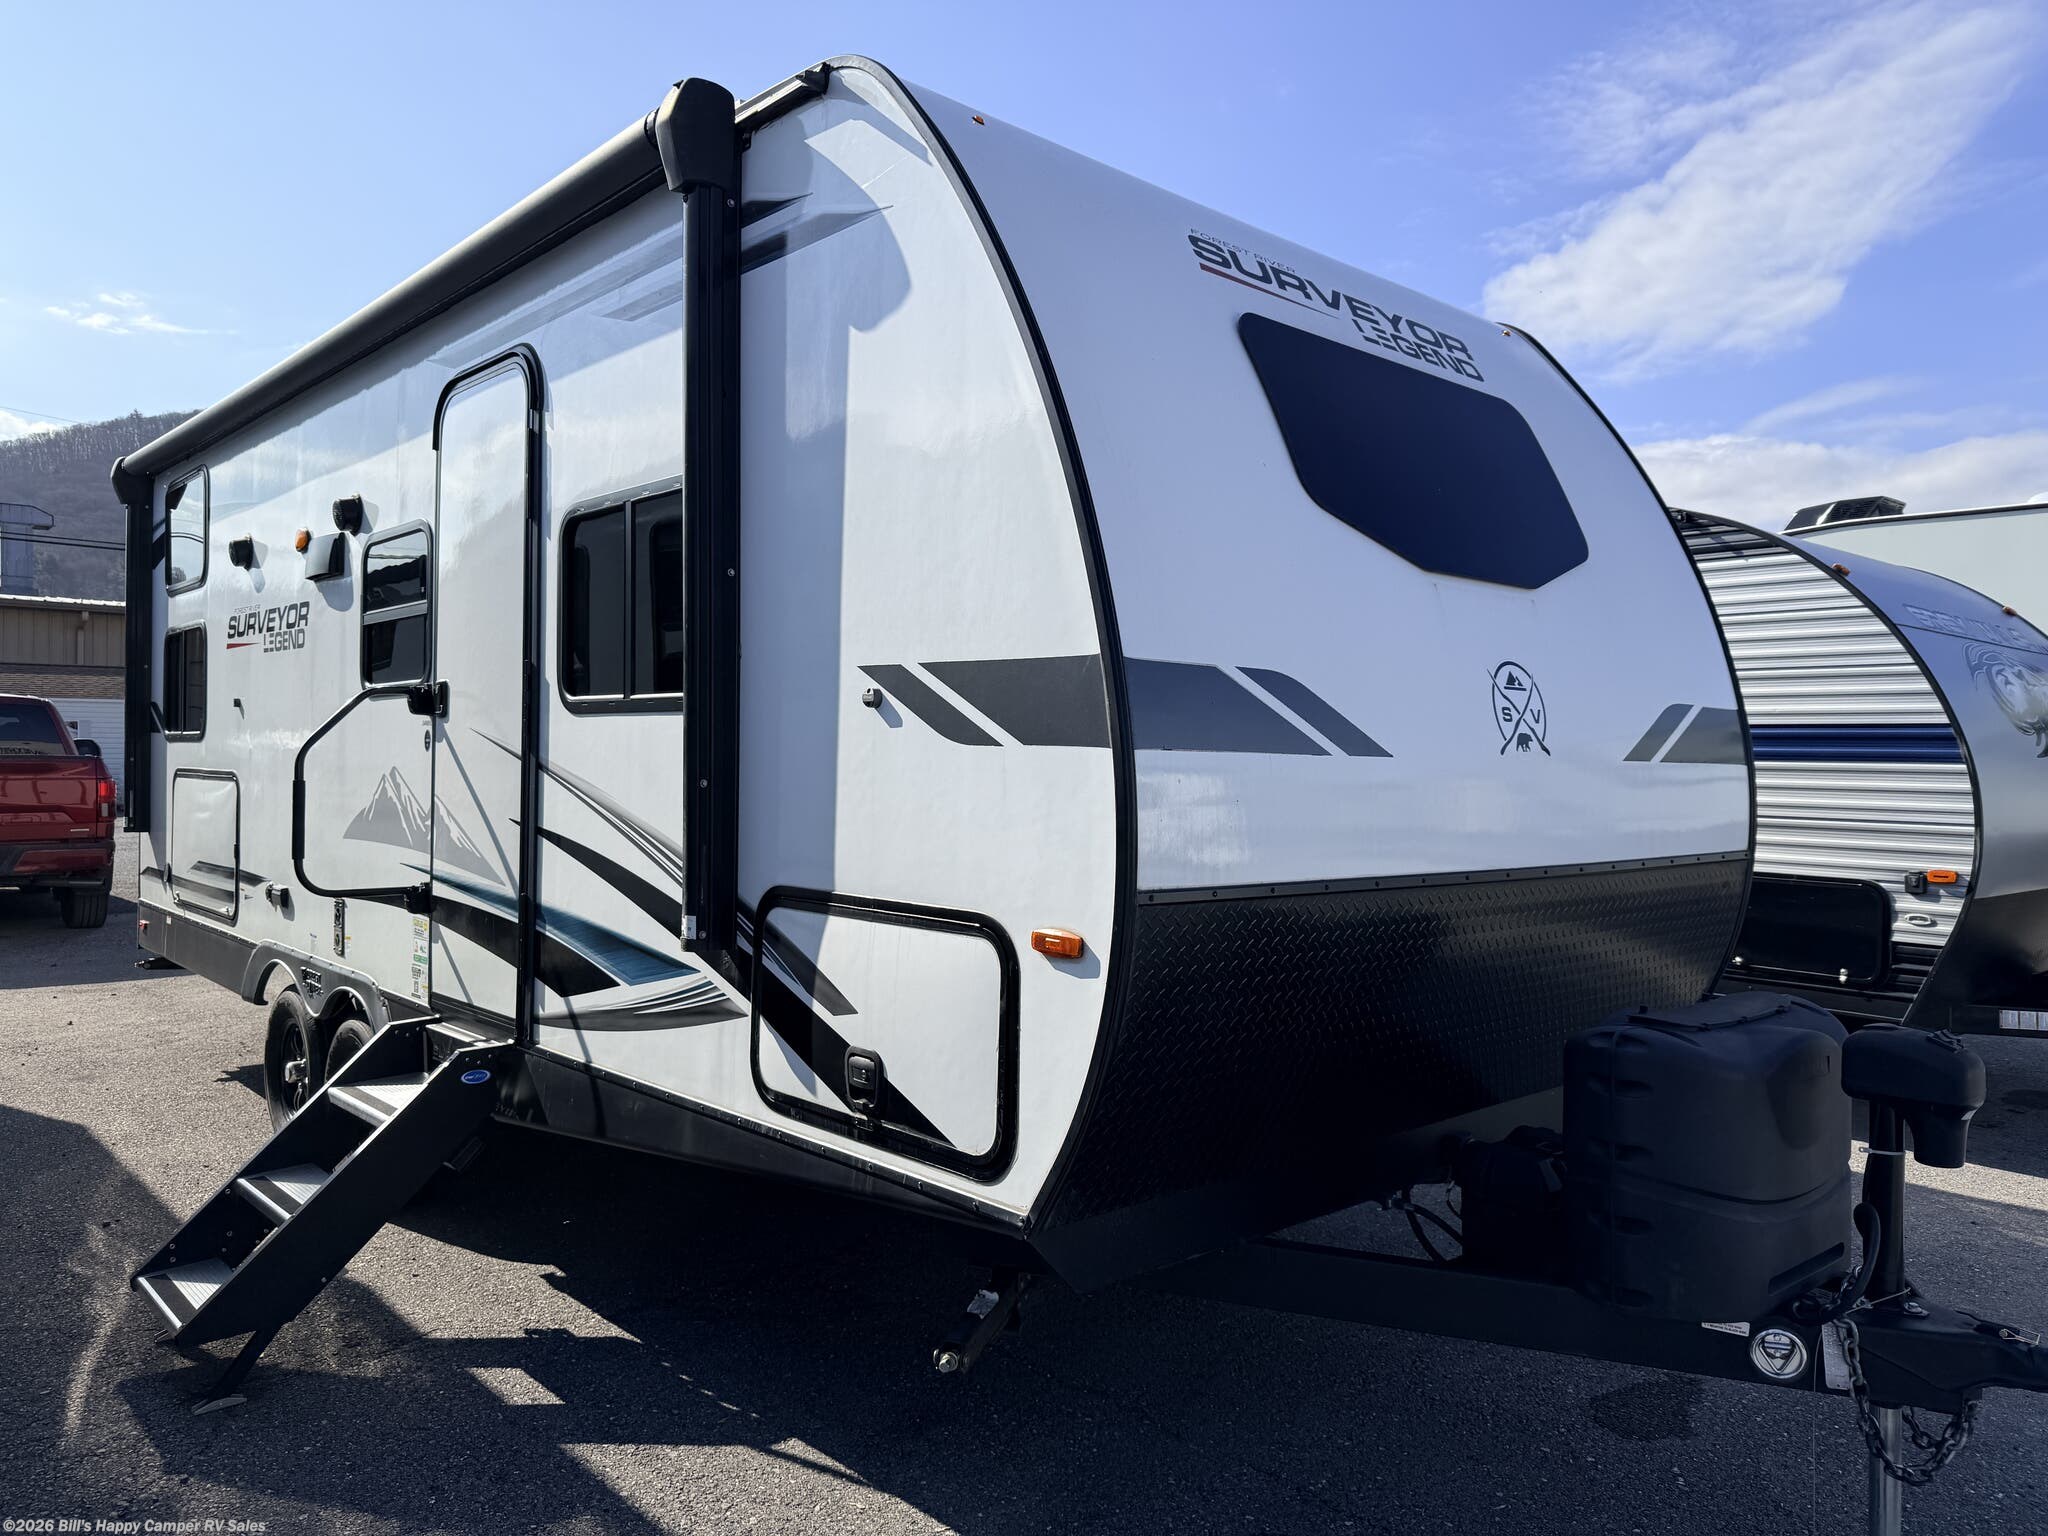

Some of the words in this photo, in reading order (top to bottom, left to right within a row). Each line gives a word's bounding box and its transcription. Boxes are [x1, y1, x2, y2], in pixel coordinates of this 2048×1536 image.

[1190, 228, 1249, 255] FOREST
[1254, 253, 1296, 273] RIVER
[1187, 233, 1474, 362] SURVEYOR
[1351, 317, 1485, 382] LEGEND
[228, 601, 310, 639] SURVEYOR
[263, 628, 305, 653] LEGEND
